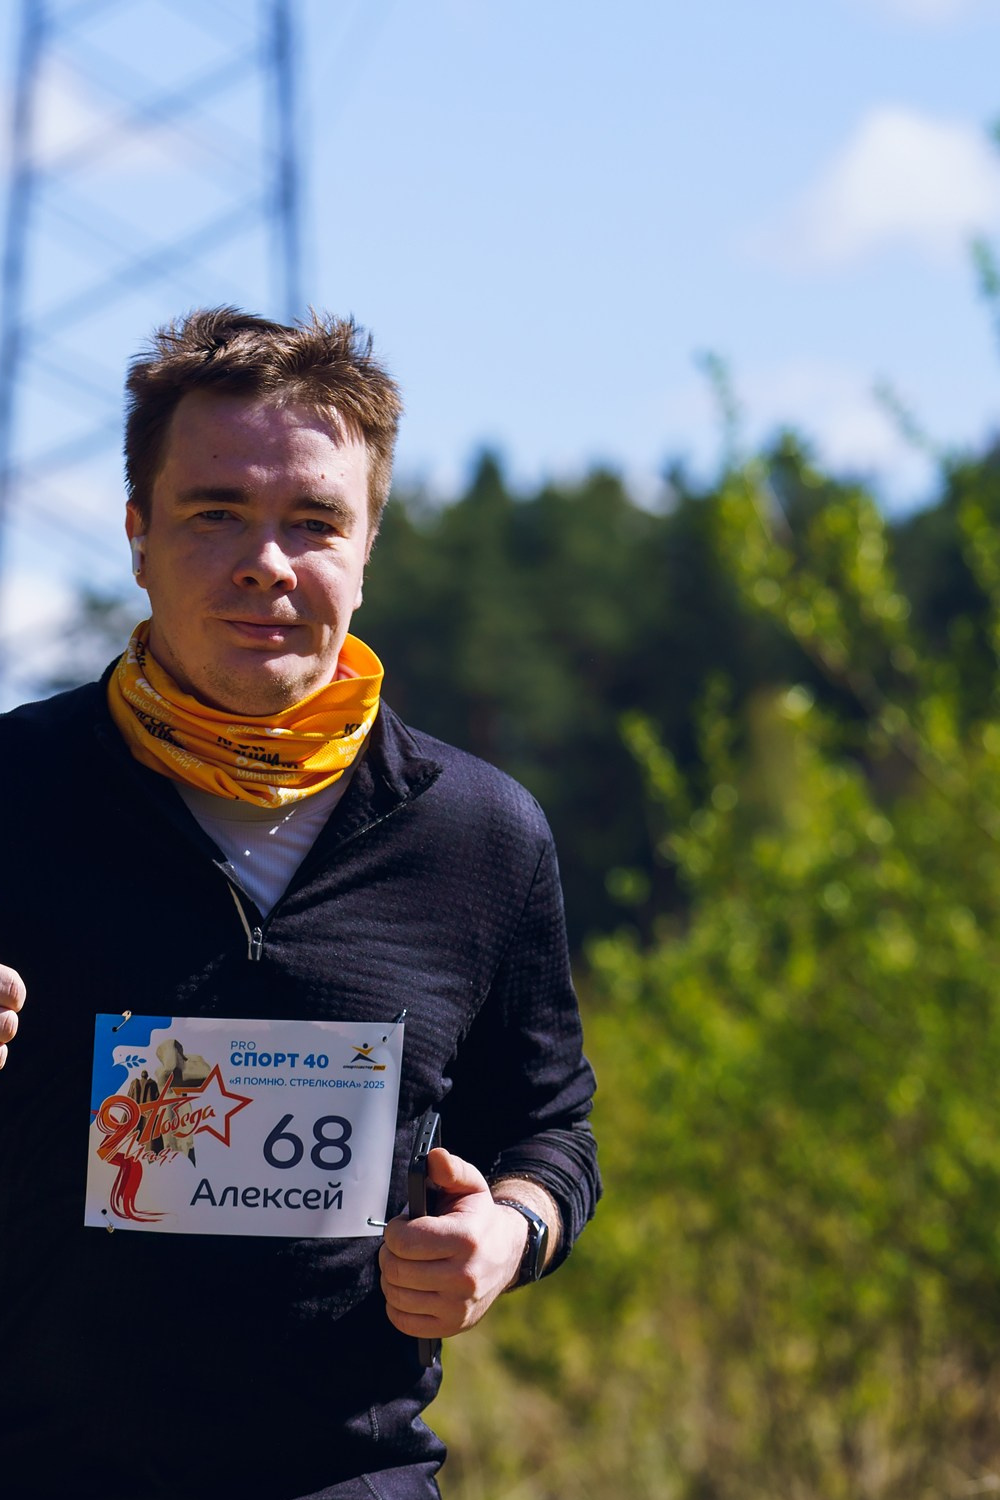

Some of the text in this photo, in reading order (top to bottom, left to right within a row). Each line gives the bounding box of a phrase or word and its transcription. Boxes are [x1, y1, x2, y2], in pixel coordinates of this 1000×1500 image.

[161, 741, 191, 770] ОССИИ
[236, 769, 296, 781] МИНСПОРТ
[231, 1041, 256, 1050] PRO
[230, 1052, 329, 1069] СПОРТ 40
[229, 1077, 385, 1090] «Я ПОМНЮ. СТРЕЛКОВКА» 2025
[138, 1094, 216, 1145] Победа
[263, 1113, 353, 1171] 68
[190, 1178, 344, 1210] Алексей
